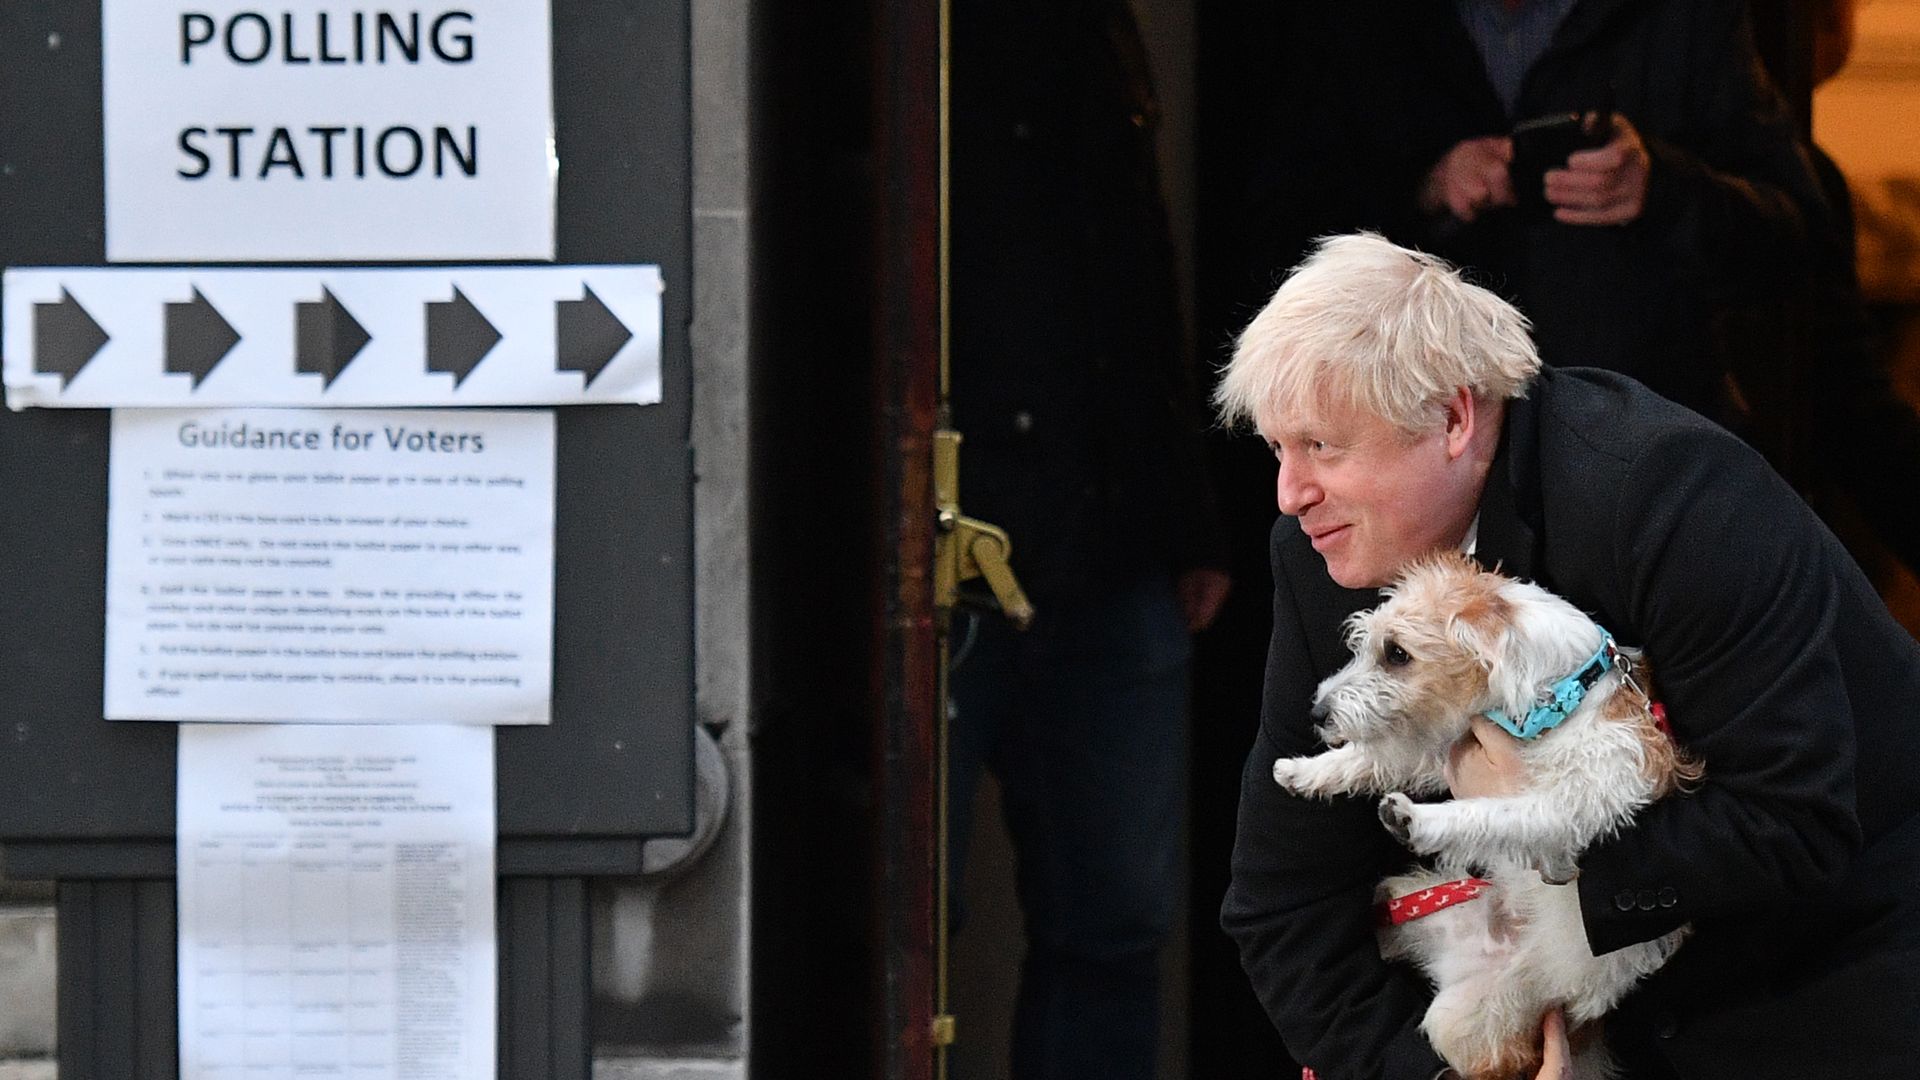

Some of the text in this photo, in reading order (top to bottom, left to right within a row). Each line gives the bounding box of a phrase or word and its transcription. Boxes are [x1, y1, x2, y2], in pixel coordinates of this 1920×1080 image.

[179, 12, 475, 64] POLLING
[176, 125, 478, 180] STATION
[178, 422, 484, 453] Guidance for Voters
